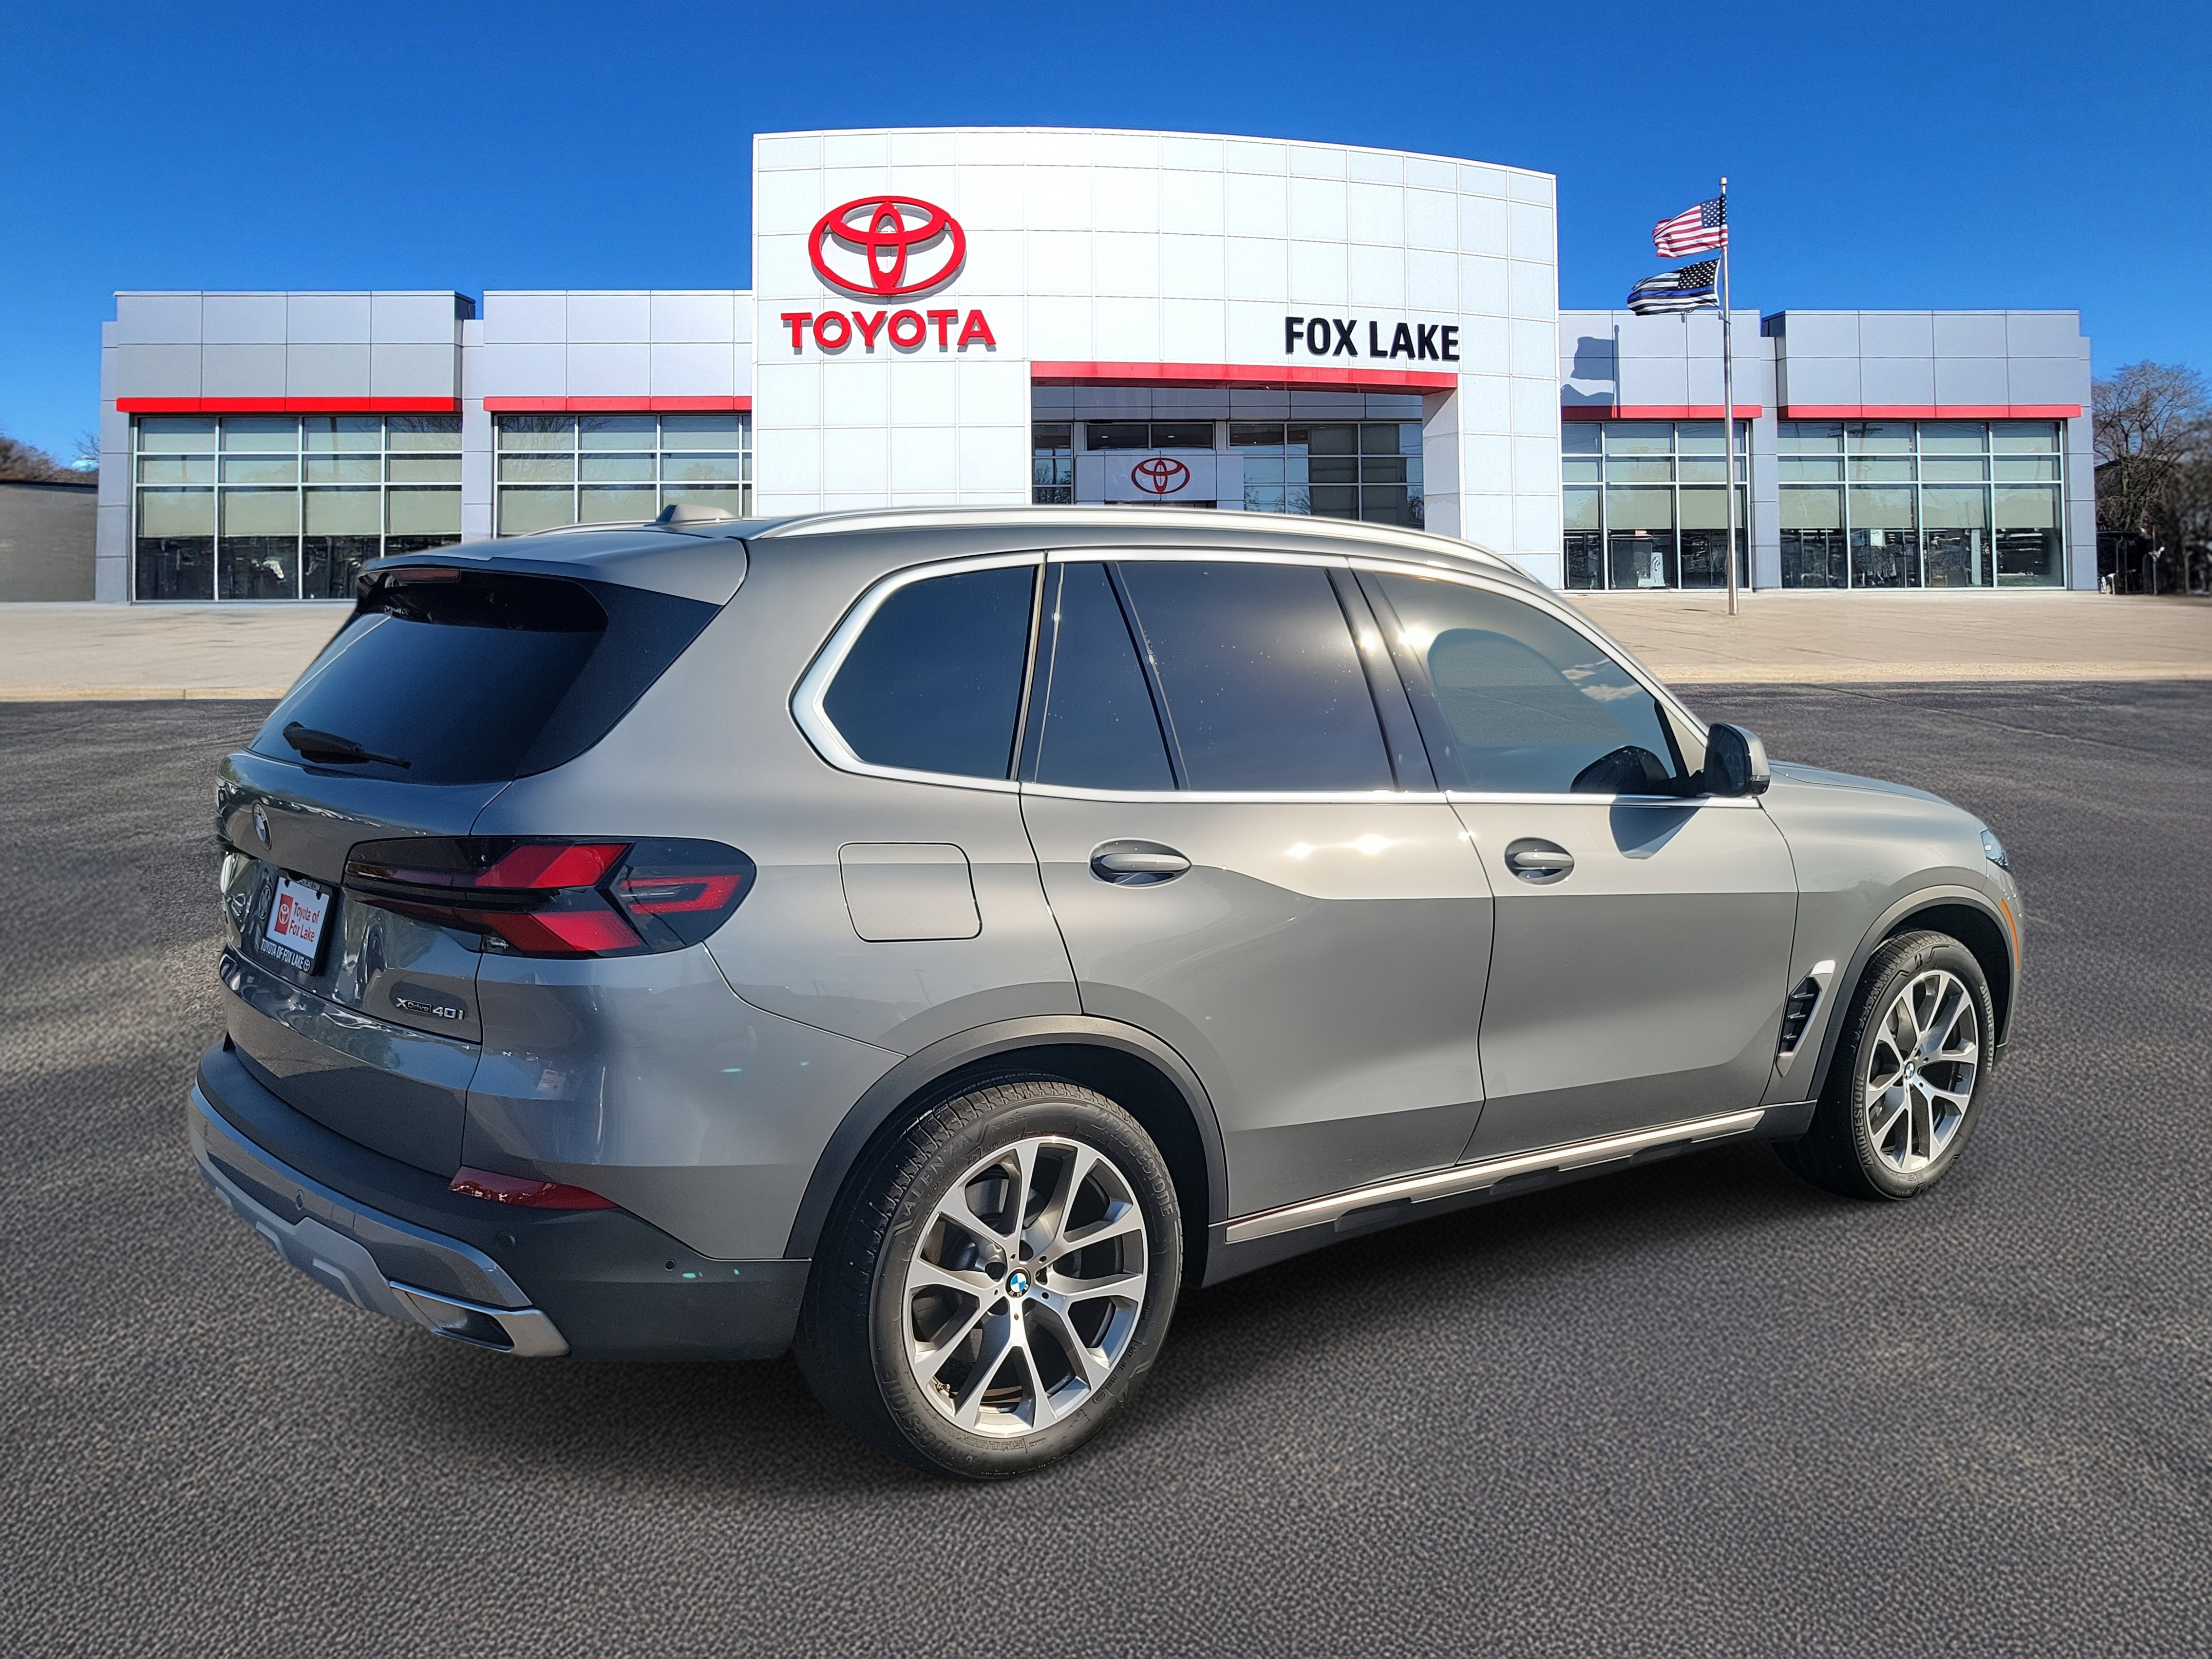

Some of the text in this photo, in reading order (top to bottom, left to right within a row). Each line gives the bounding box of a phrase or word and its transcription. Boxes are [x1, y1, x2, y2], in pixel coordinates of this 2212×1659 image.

[781, 310, 996, 351] TOYOTA
[1286, 316, 1460, 360] FOX LAKE
[293, 902, 320, 924] Toyota of
[289, 920, 315, 943] Fox Lake
